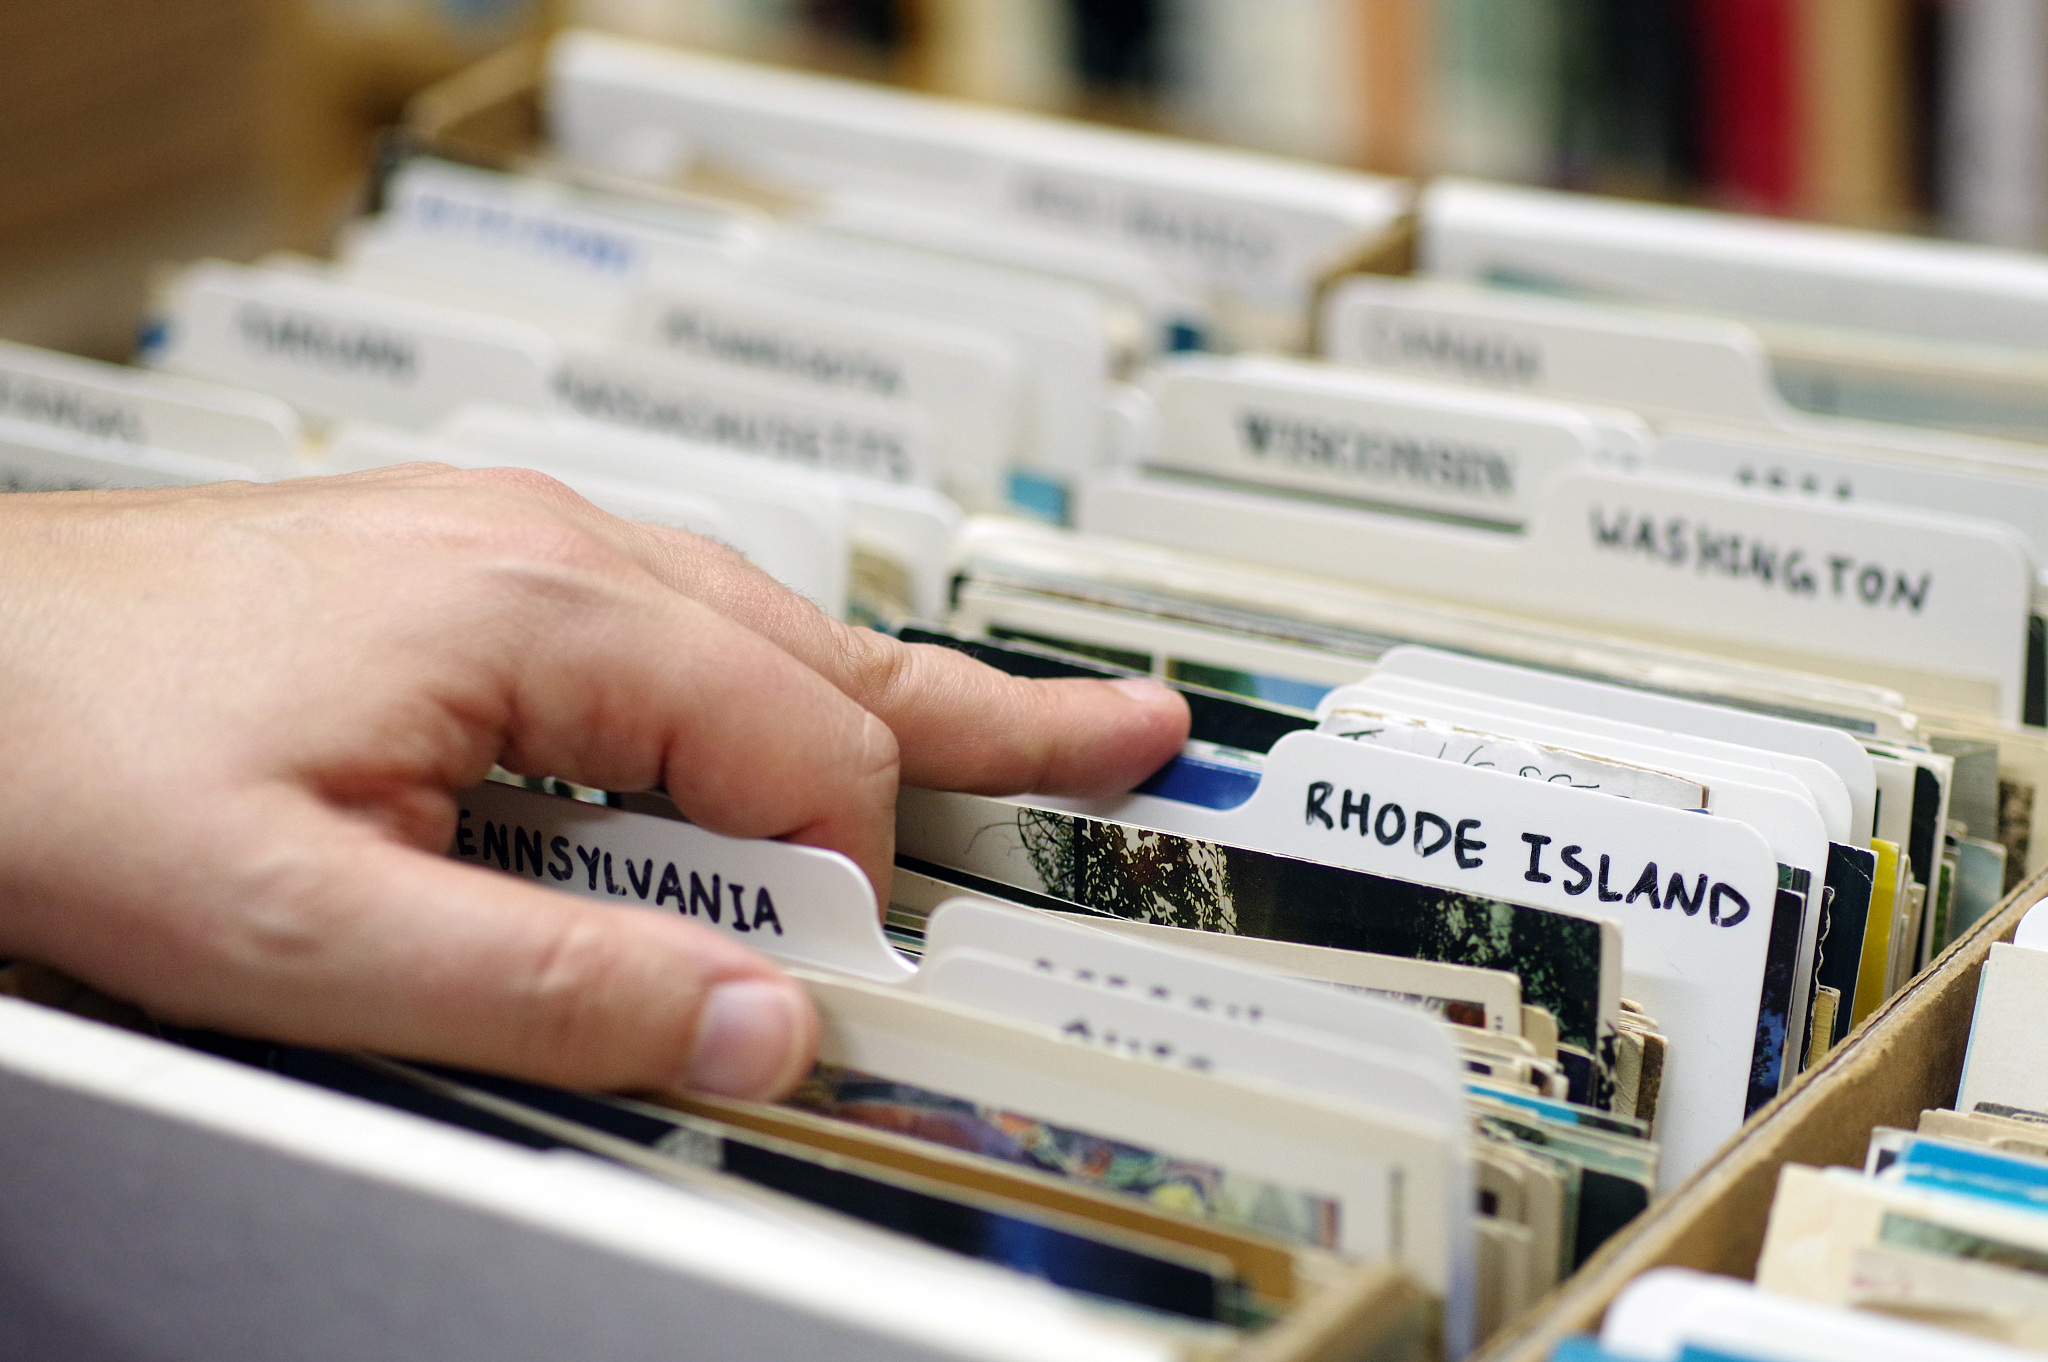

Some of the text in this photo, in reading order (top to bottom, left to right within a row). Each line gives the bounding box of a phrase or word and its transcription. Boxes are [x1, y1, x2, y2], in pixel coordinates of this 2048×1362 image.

[1238, 408, 1518, 496] WISCONSIN
[1588, 504, 1934, 616] WASHINGTON
[455, 808, 784, 936] ENNSYLVANIA
[1305, 780, 1752, 928] RHODE ISLAND
